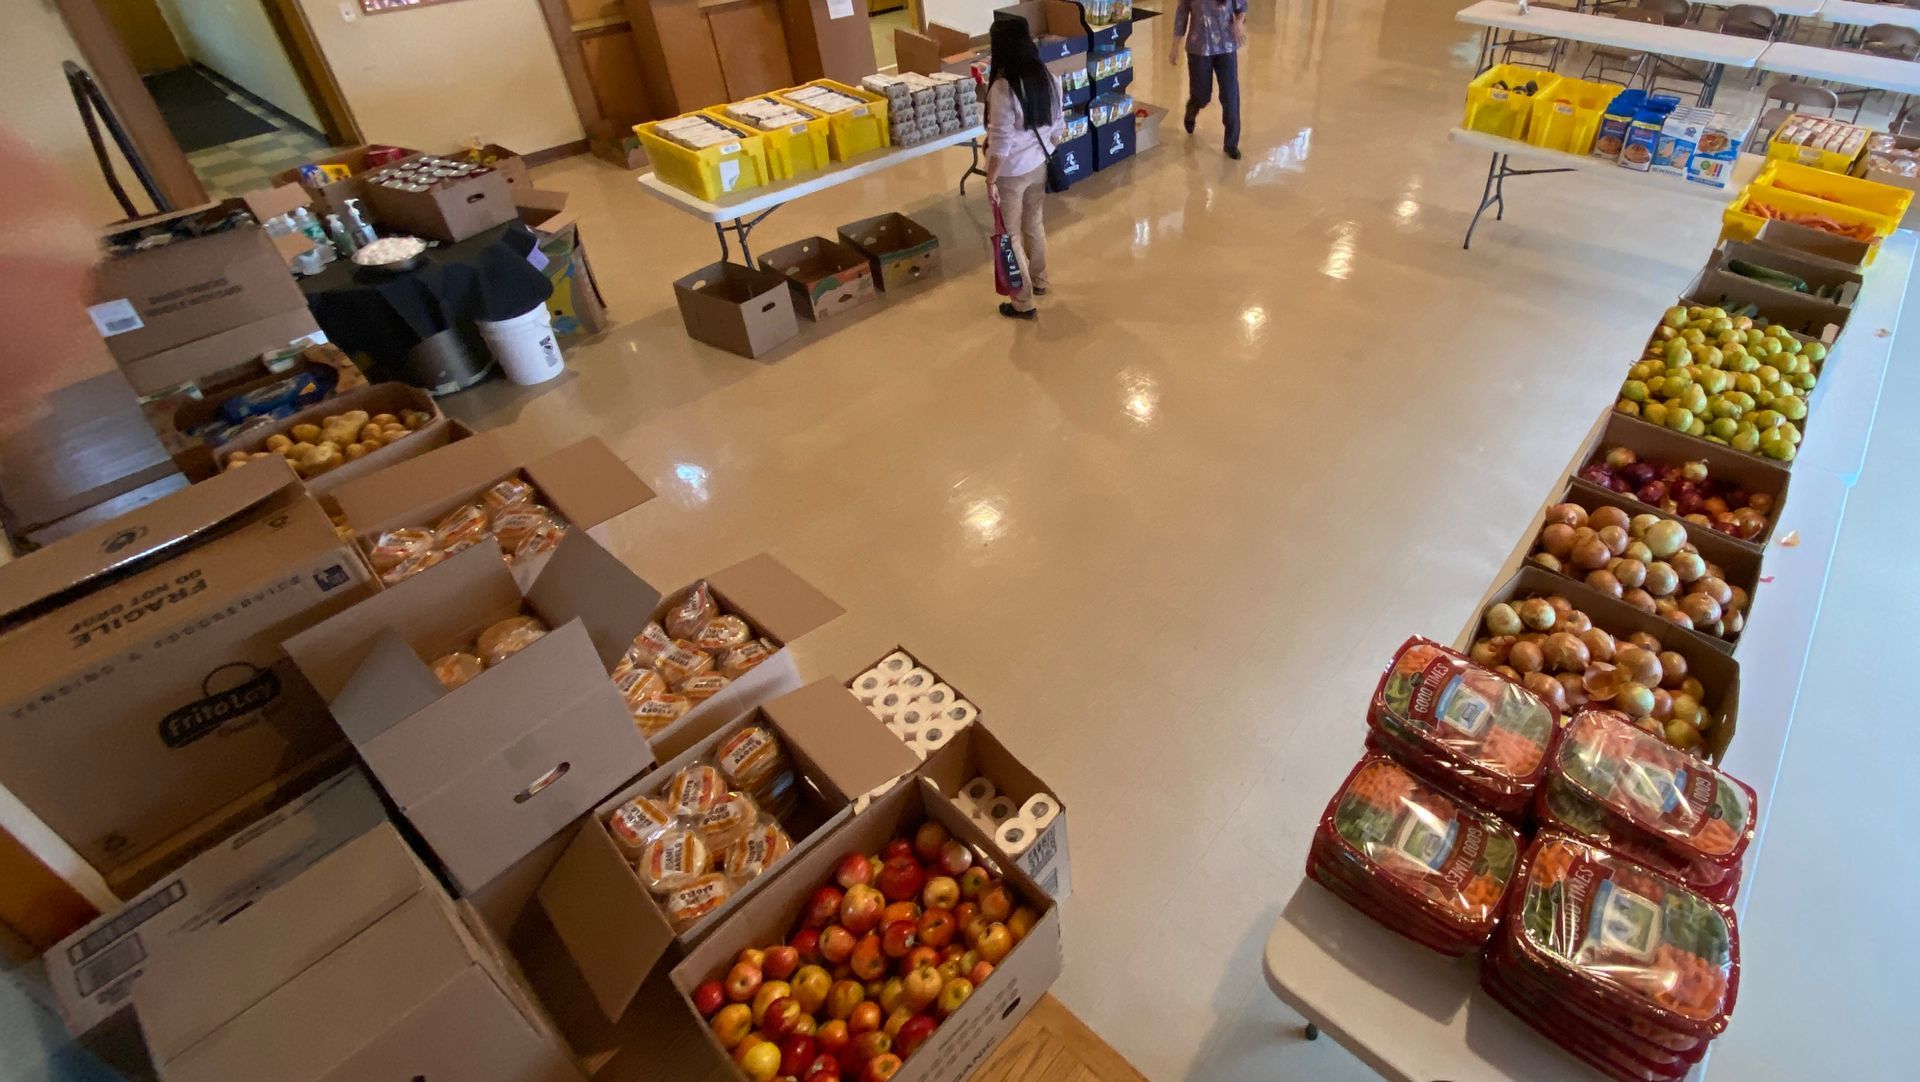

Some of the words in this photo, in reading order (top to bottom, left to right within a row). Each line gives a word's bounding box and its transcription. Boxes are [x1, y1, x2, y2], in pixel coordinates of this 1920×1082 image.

[130, 583, 169, 606] NOT
[68, 603, 124, 634] DROP
[72, 579, 207, 649] FRAGILE
[1414, 684, 1433, 714] GOOD
[1424, 662, 1449, 689] TIMES
[1693, 776, 1712, 803] GOOD
[1680, 801, 1707, 828] TIMES
[1463, 827, 1483, 858] GOOD
[1444, 856, 1474, 890] TIMES
[1568, 864, 1594, 903] TIMES
